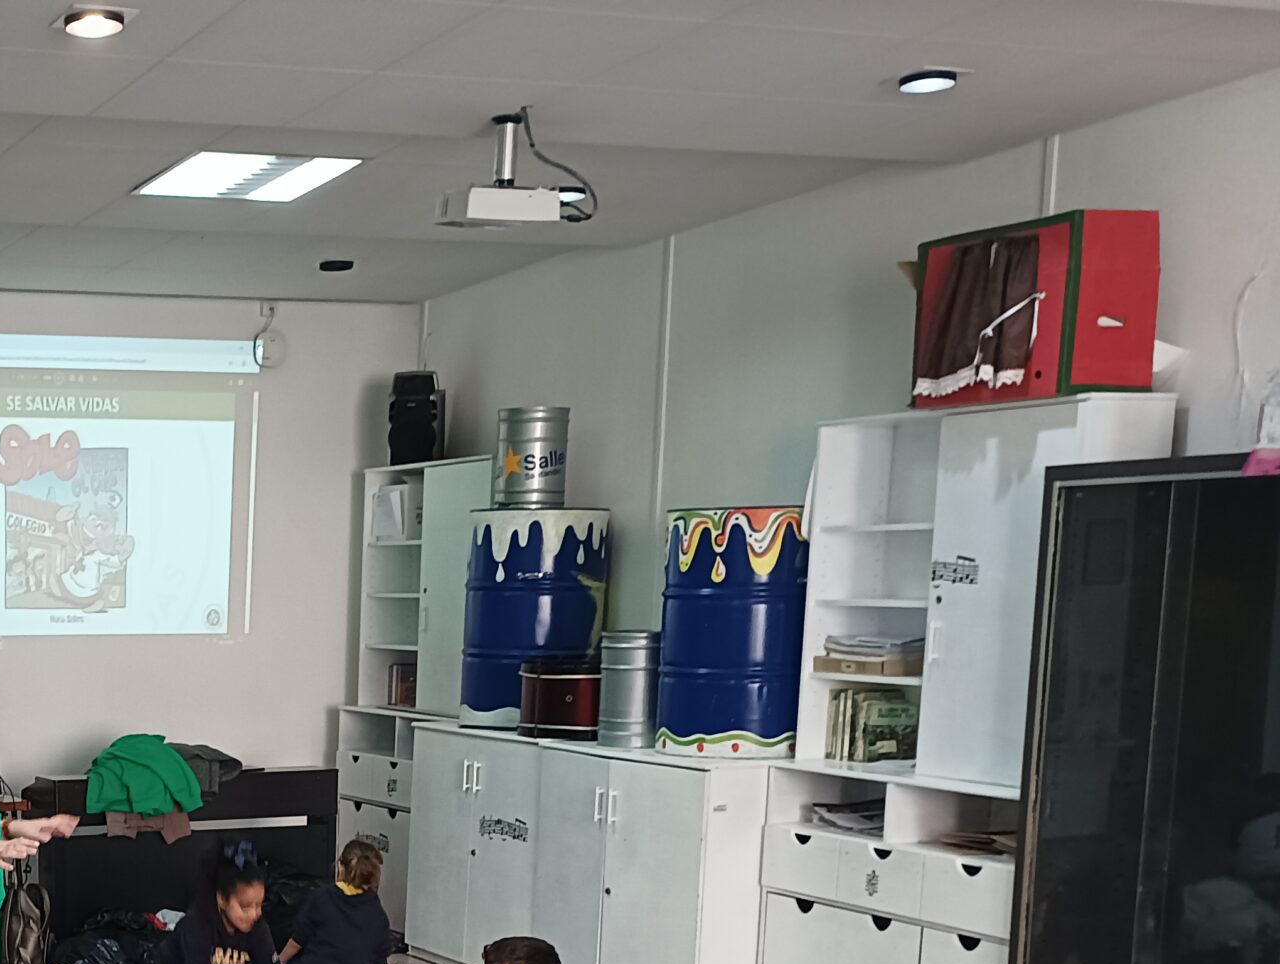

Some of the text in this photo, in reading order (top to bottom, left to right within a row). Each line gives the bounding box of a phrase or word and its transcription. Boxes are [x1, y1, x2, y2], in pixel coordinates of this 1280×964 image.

[6, 395, 120, 413] SE SALVAR VIDAS
[523, 449, 566, 471] Salle
[6, 514, 47, 534] COLEGIO
